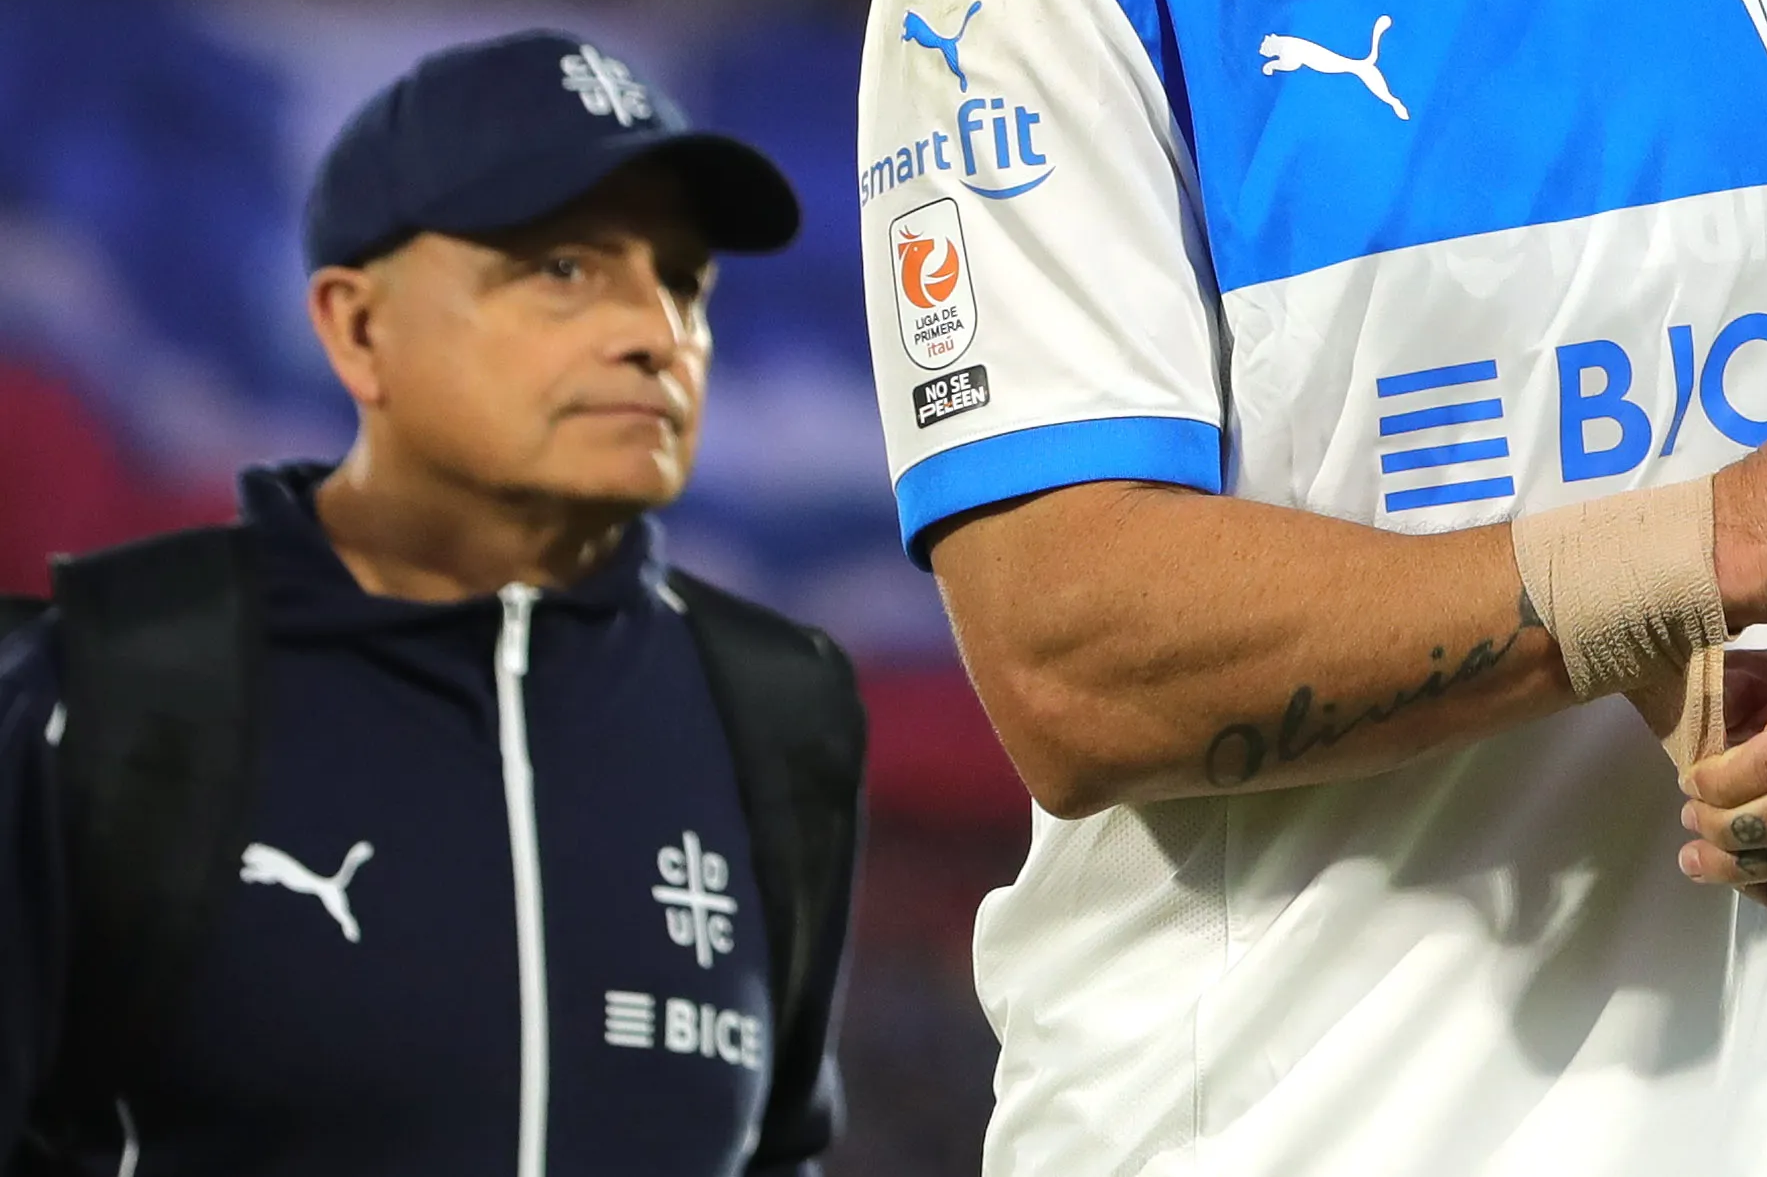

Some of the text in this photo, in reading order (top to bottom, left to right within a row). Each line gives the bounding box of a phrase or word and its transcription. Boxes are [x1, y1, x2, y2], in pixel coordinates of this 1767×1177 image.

[861, 97, 1047, 208] smart fit
[914, 319, 965, 345] PRIMERA
[915, 305, 958, 331] LIGA DE
[918, 385, 986, 424] PELEEN
[925, 372, 972, 403] NO SE
[664, 997, 760, 1070] BICE
